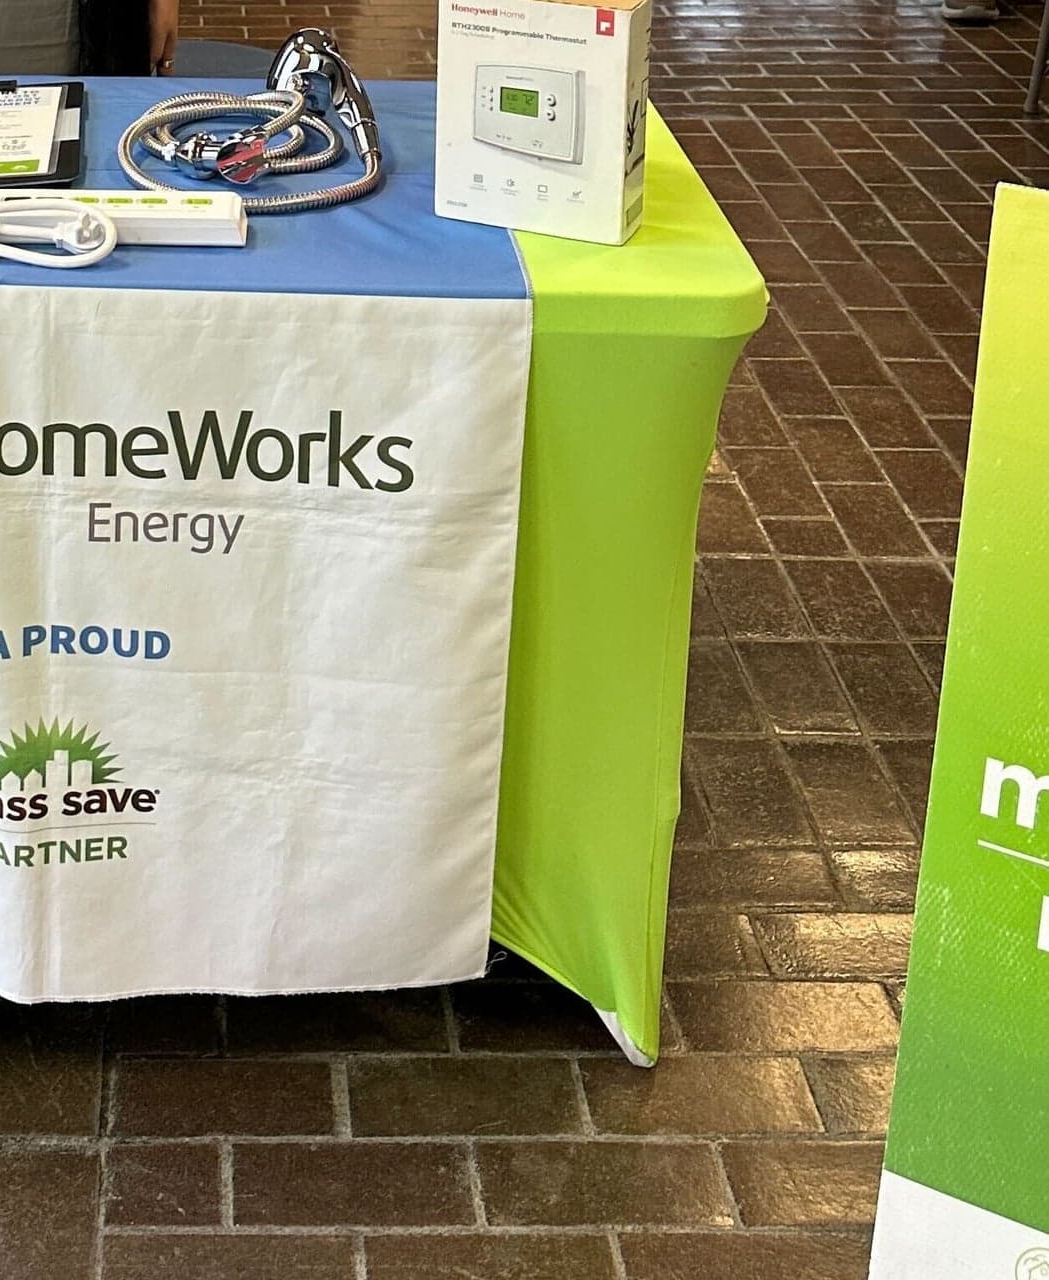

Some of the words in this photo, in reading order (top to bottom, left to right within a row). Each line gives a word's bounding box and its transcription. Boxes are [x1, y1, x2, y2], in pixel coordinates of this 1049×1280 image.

[451, 3, 498, 17] Honeywell
[499, 10, 526, 20] Home
[491, 27, 544, 40] Programmable
[545, 33, 588, 45] Thermostat
[87, 501, 245, 554] Energy
[22, 624, 171, 660] PROUD
